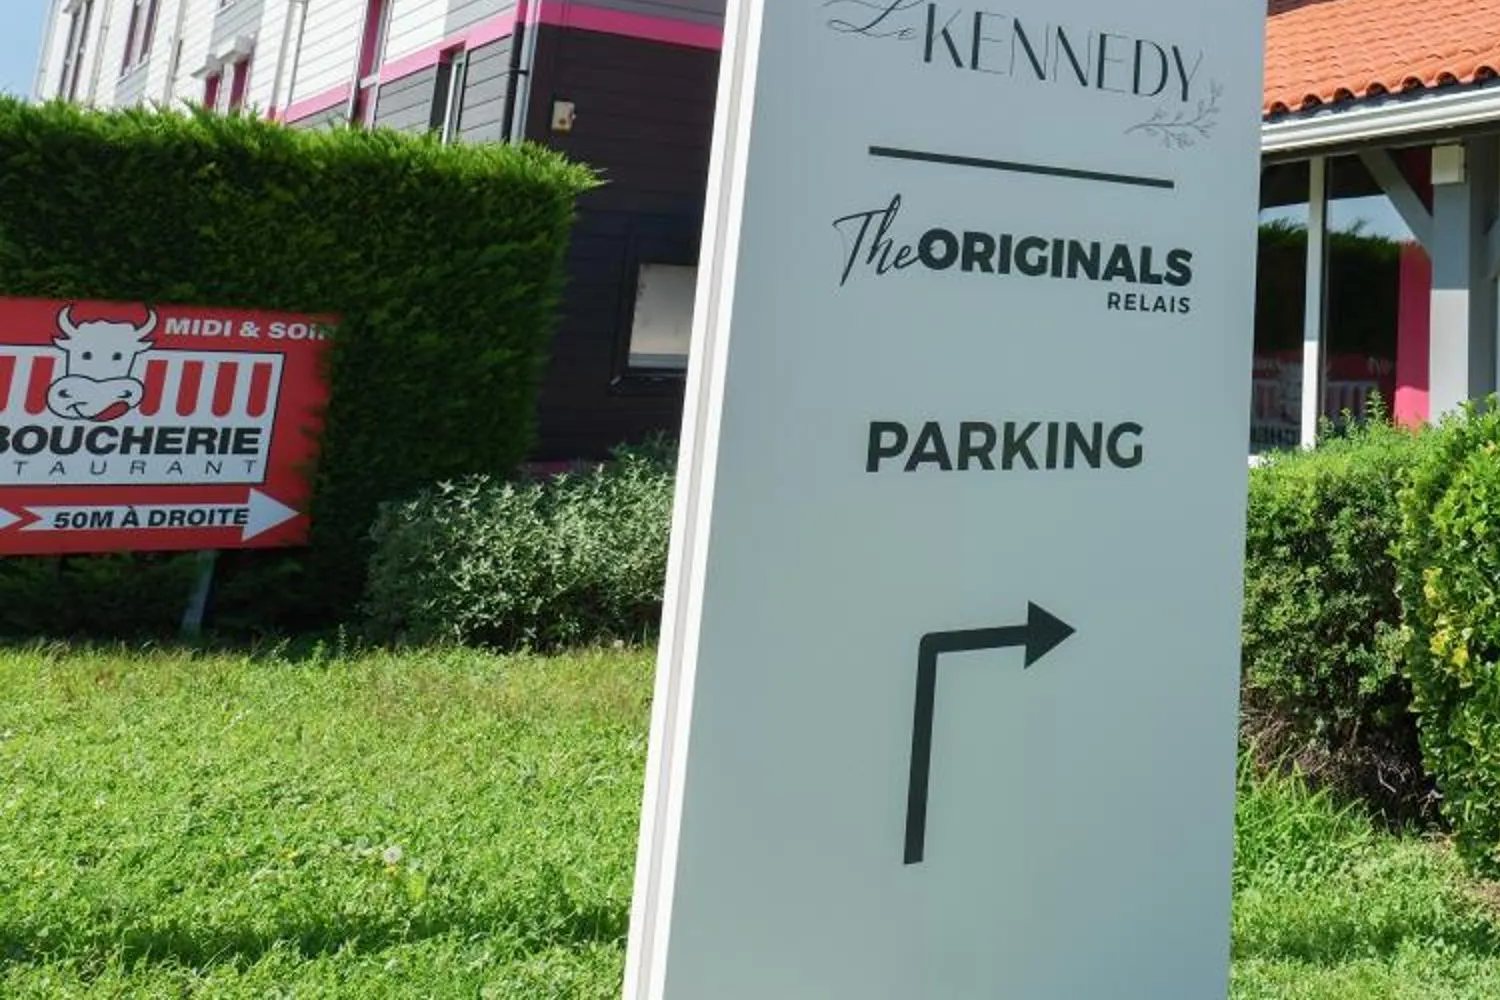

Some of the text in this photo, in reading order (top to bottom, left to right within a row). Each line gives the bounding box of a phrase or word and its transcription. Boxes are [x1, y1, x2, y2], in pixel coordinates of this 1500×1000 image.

[923, 3, 1203, 102] KENNEDY
[832, 194, 1194, 287] The ORIGINALS
[1107, 292, 1192, 315] RELAIS
[164, 317, 233, 338] MIDI
[239, 320, 261, 339] &
[866, 421, 1144, 473] PARKING
[53, 505, 249, 529] 50M À DROITE
